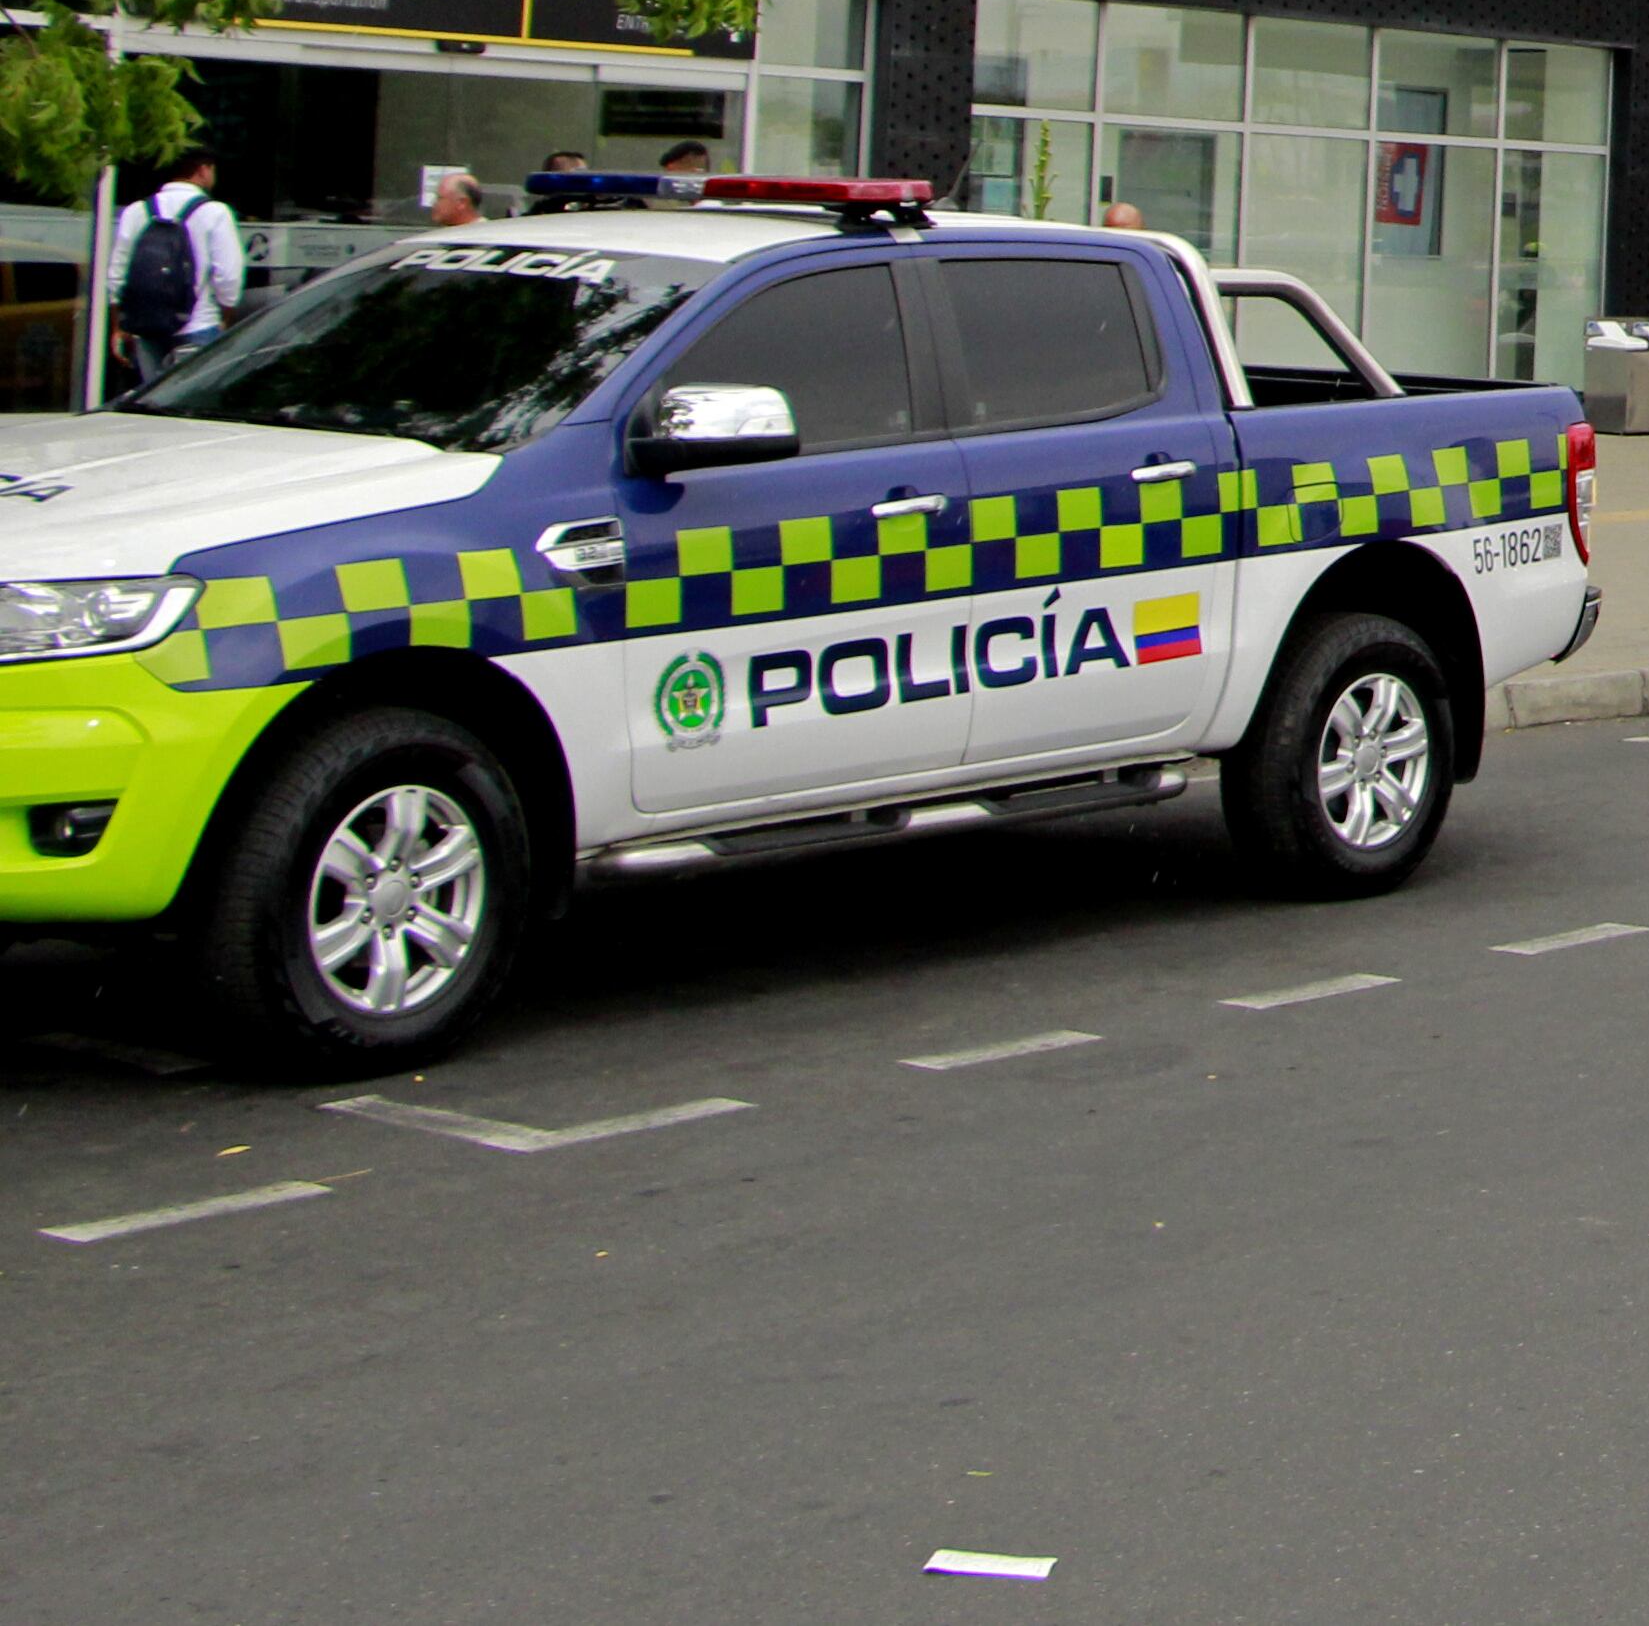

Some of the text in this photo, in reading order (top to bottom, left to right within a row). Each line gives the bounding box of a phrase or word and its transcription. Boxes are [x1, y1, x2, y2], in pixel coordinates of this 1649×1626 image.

[389, 250, 616, 284] POLICÍA
[1473, 528, 1542, 574] 56-1862
[748, 587, 1130, 728] POLICÍA
